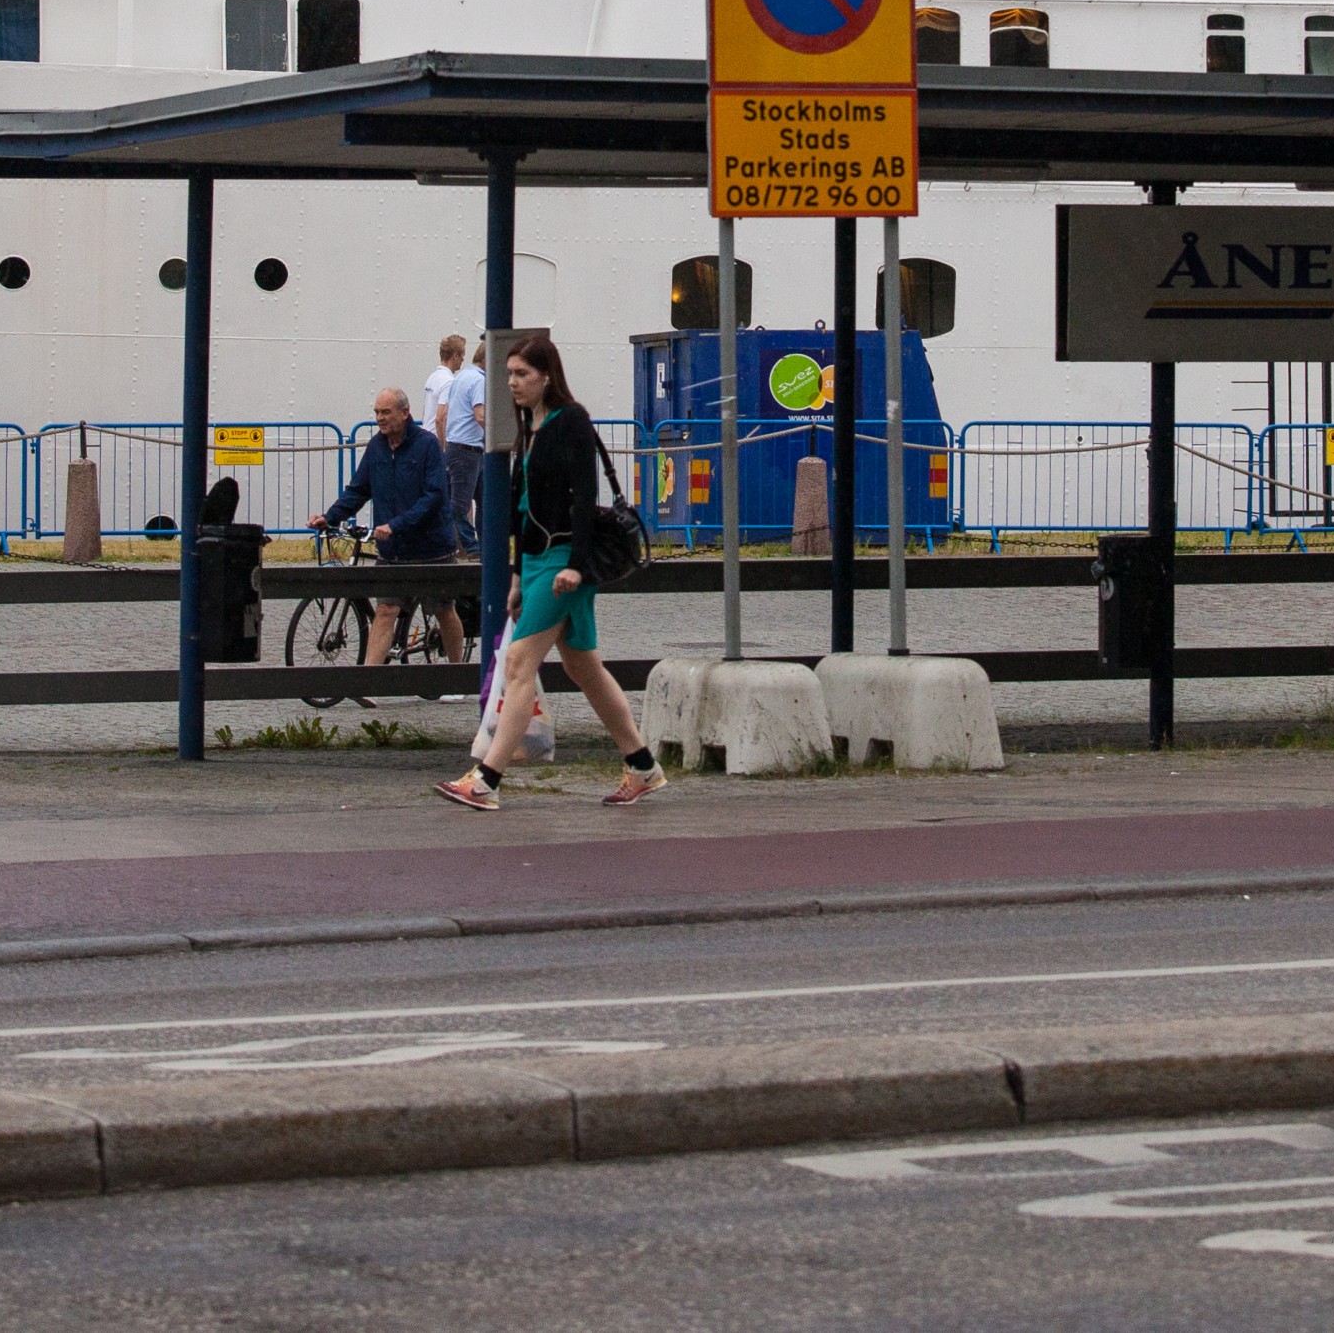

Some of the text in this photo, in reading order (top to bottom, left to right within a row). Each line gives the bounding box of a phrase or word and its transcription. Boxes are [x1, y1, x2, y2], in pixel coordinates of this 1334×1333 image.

[742, 100, 886, 122] Stockholms
[780, 128, 850, 150] Stads
[725, 156, 906, 183] Parkerings AB
[726, 185, 901, 207] 08/772 96 00
